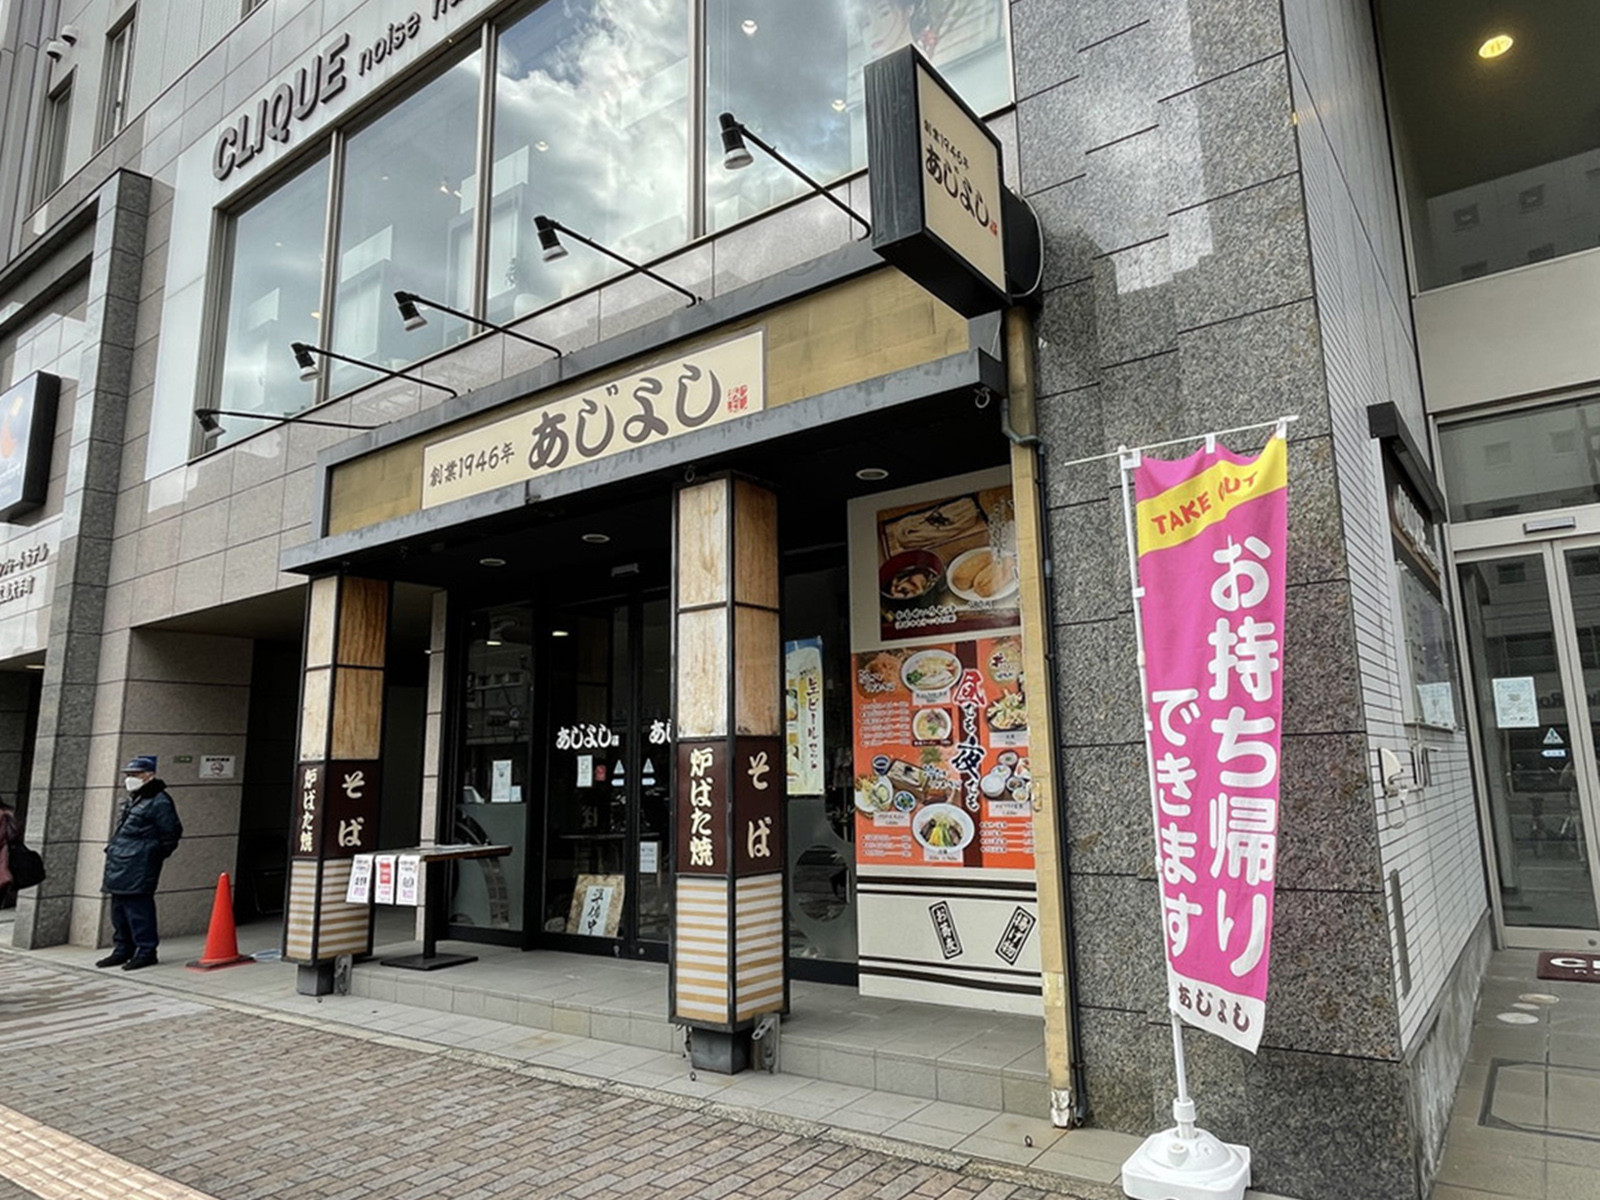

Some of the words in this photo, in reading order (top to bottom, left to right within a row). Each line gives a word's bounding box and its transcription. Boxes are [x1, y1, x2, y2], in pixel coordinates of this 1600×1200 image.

[213, 33, 350, 181] CLIQUE
[359, 12, 421, 76] noise
[926, 144, 989, 228] あじよし
[430, 442, 515, 487] 創業1946年
[529, 363, 722, 470] あじよし
[1151, 491, 1212, 535] TAKE
[556, 723, 612, 750] あじよし
[1208, 534, 1279, 977] お持ち帰り
[299, 768, 318, 852] 炉ばた焼
[338, 770, 366, 847] そば
[690, 747, 713, 866] 炉ばた焼
[747, 751, 772, 858] そば
[1152, 689, 1203, 957] できます
[1178, 983, 1250, 1032] あじよし
